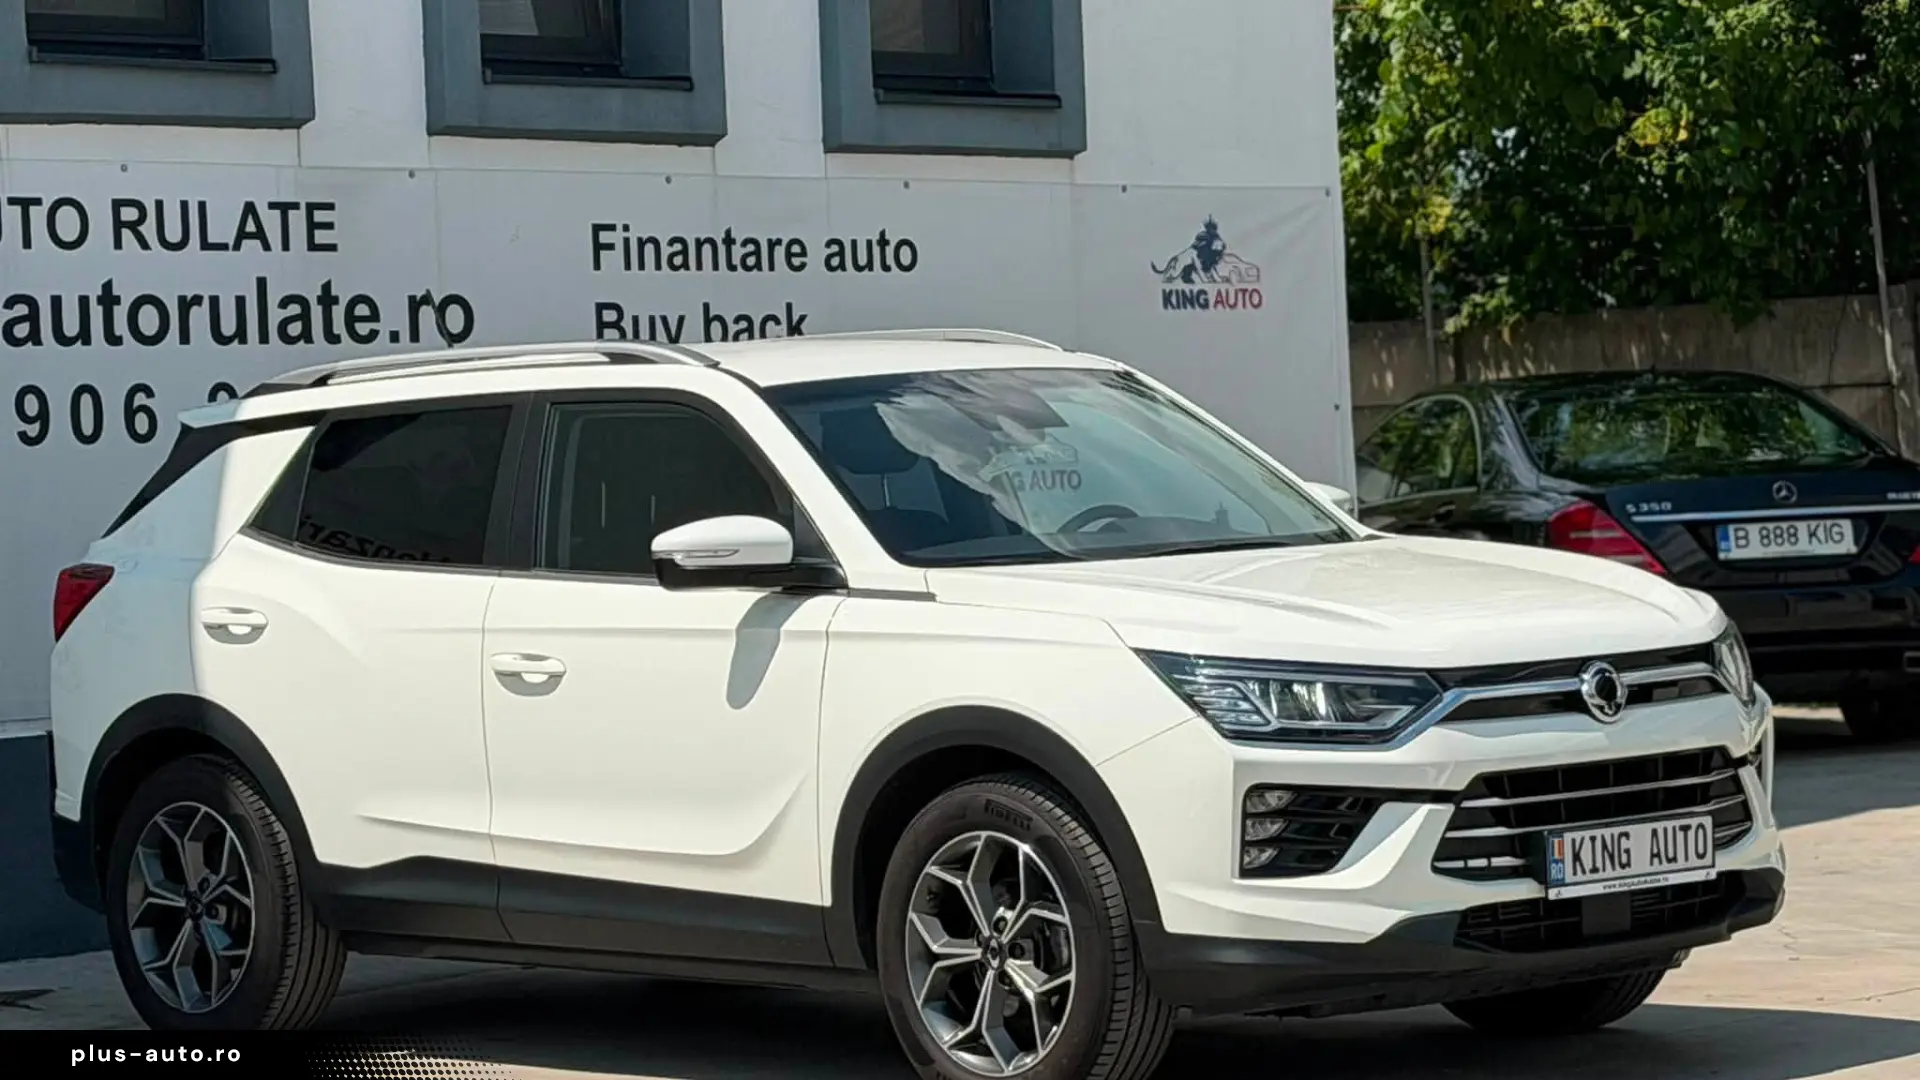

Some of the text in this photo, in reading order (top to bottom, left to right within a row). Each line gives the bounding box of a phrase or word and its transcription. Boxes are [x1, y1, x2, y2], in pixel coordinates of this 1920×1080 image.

[0, 196, 338, 253] TO RULATE
[590, 222, 918, 273] Finantare auto
[1, 276, 475, 347] autorulate.ro
[702, 301, 808, 343] back
[1162, 288, 1263, 310] KING AUTO
[1028, 469, 1082, 492] AUTO
[1734, 522, 1845, 549] B 888 KIG
[1571, 822, 1708, 876] KING AUTO
